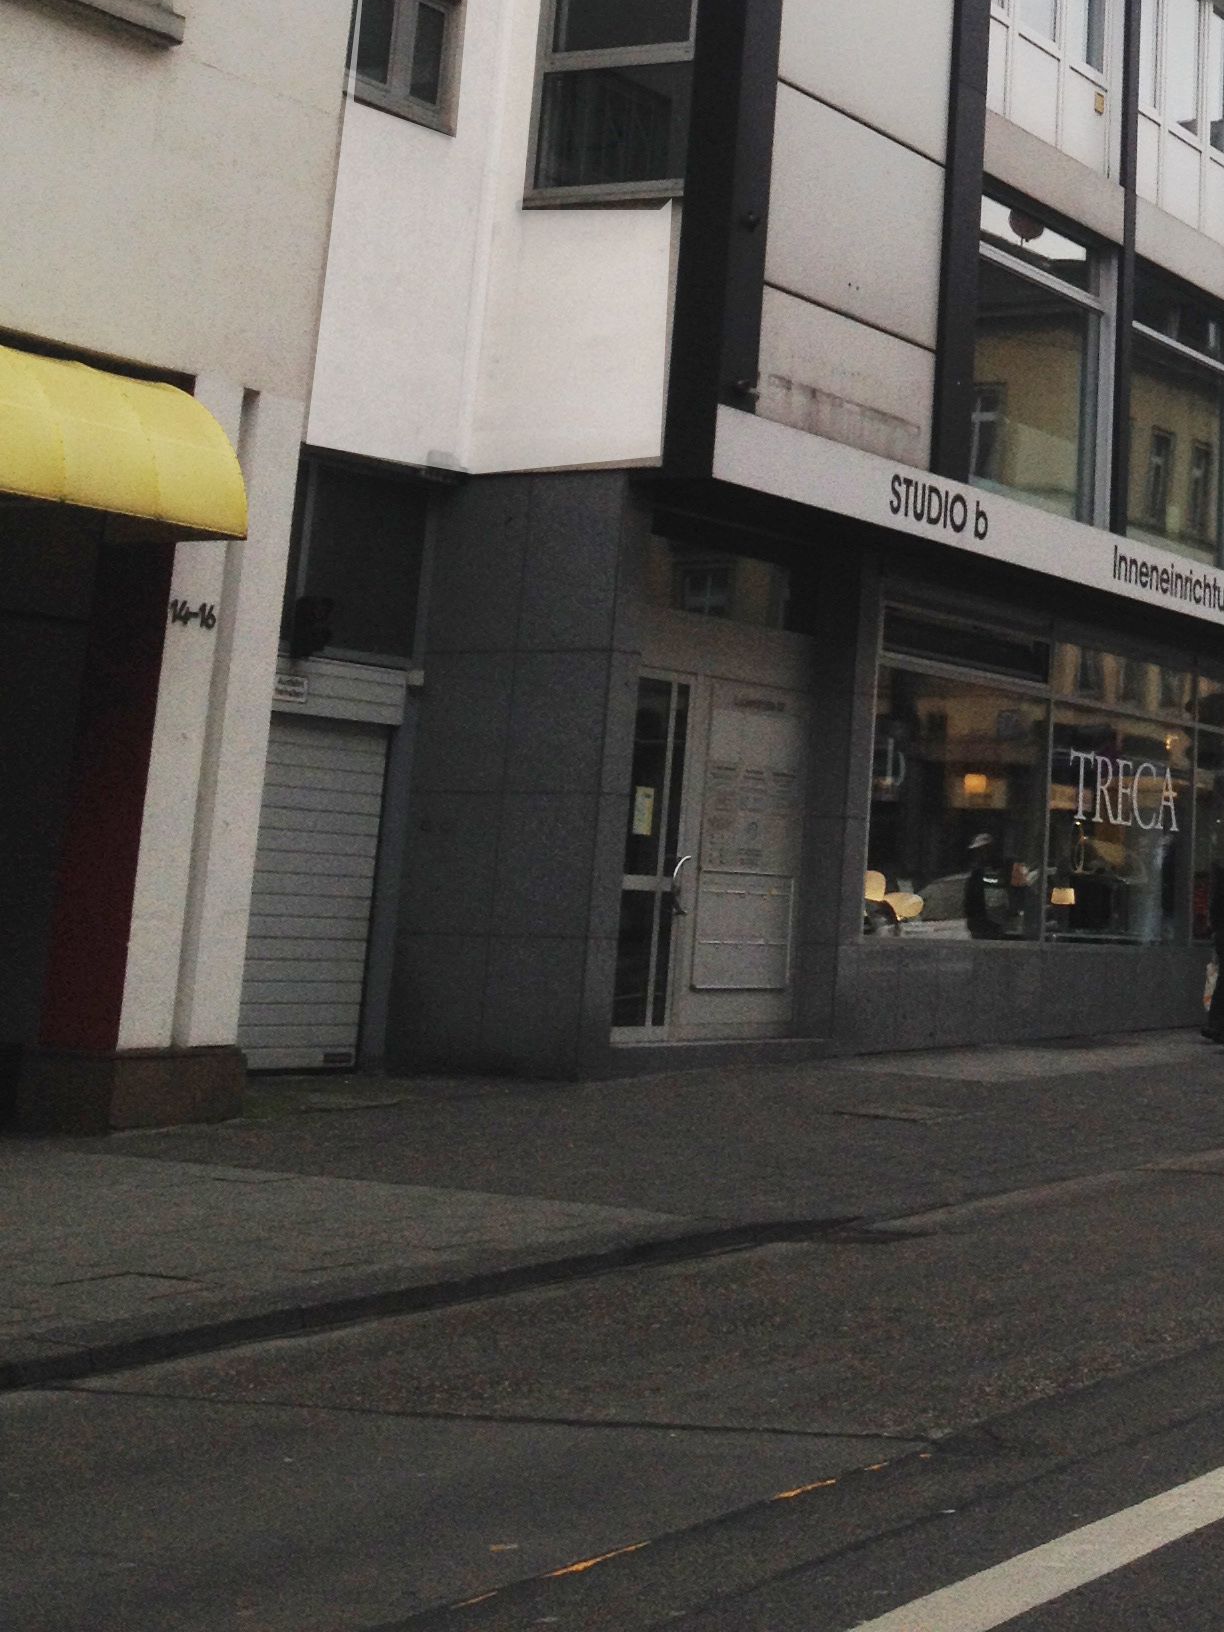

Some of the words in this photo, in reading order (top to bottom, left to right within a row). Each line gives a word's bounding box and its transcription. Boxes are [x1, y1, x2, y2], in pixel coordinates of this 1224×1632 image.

[889, 473, 968, 534] STUDIO
[973, 499, 989, 541] b
[169, 598, 217, 630] 14-16
[1069, 748, 1180, 832] TRECA
